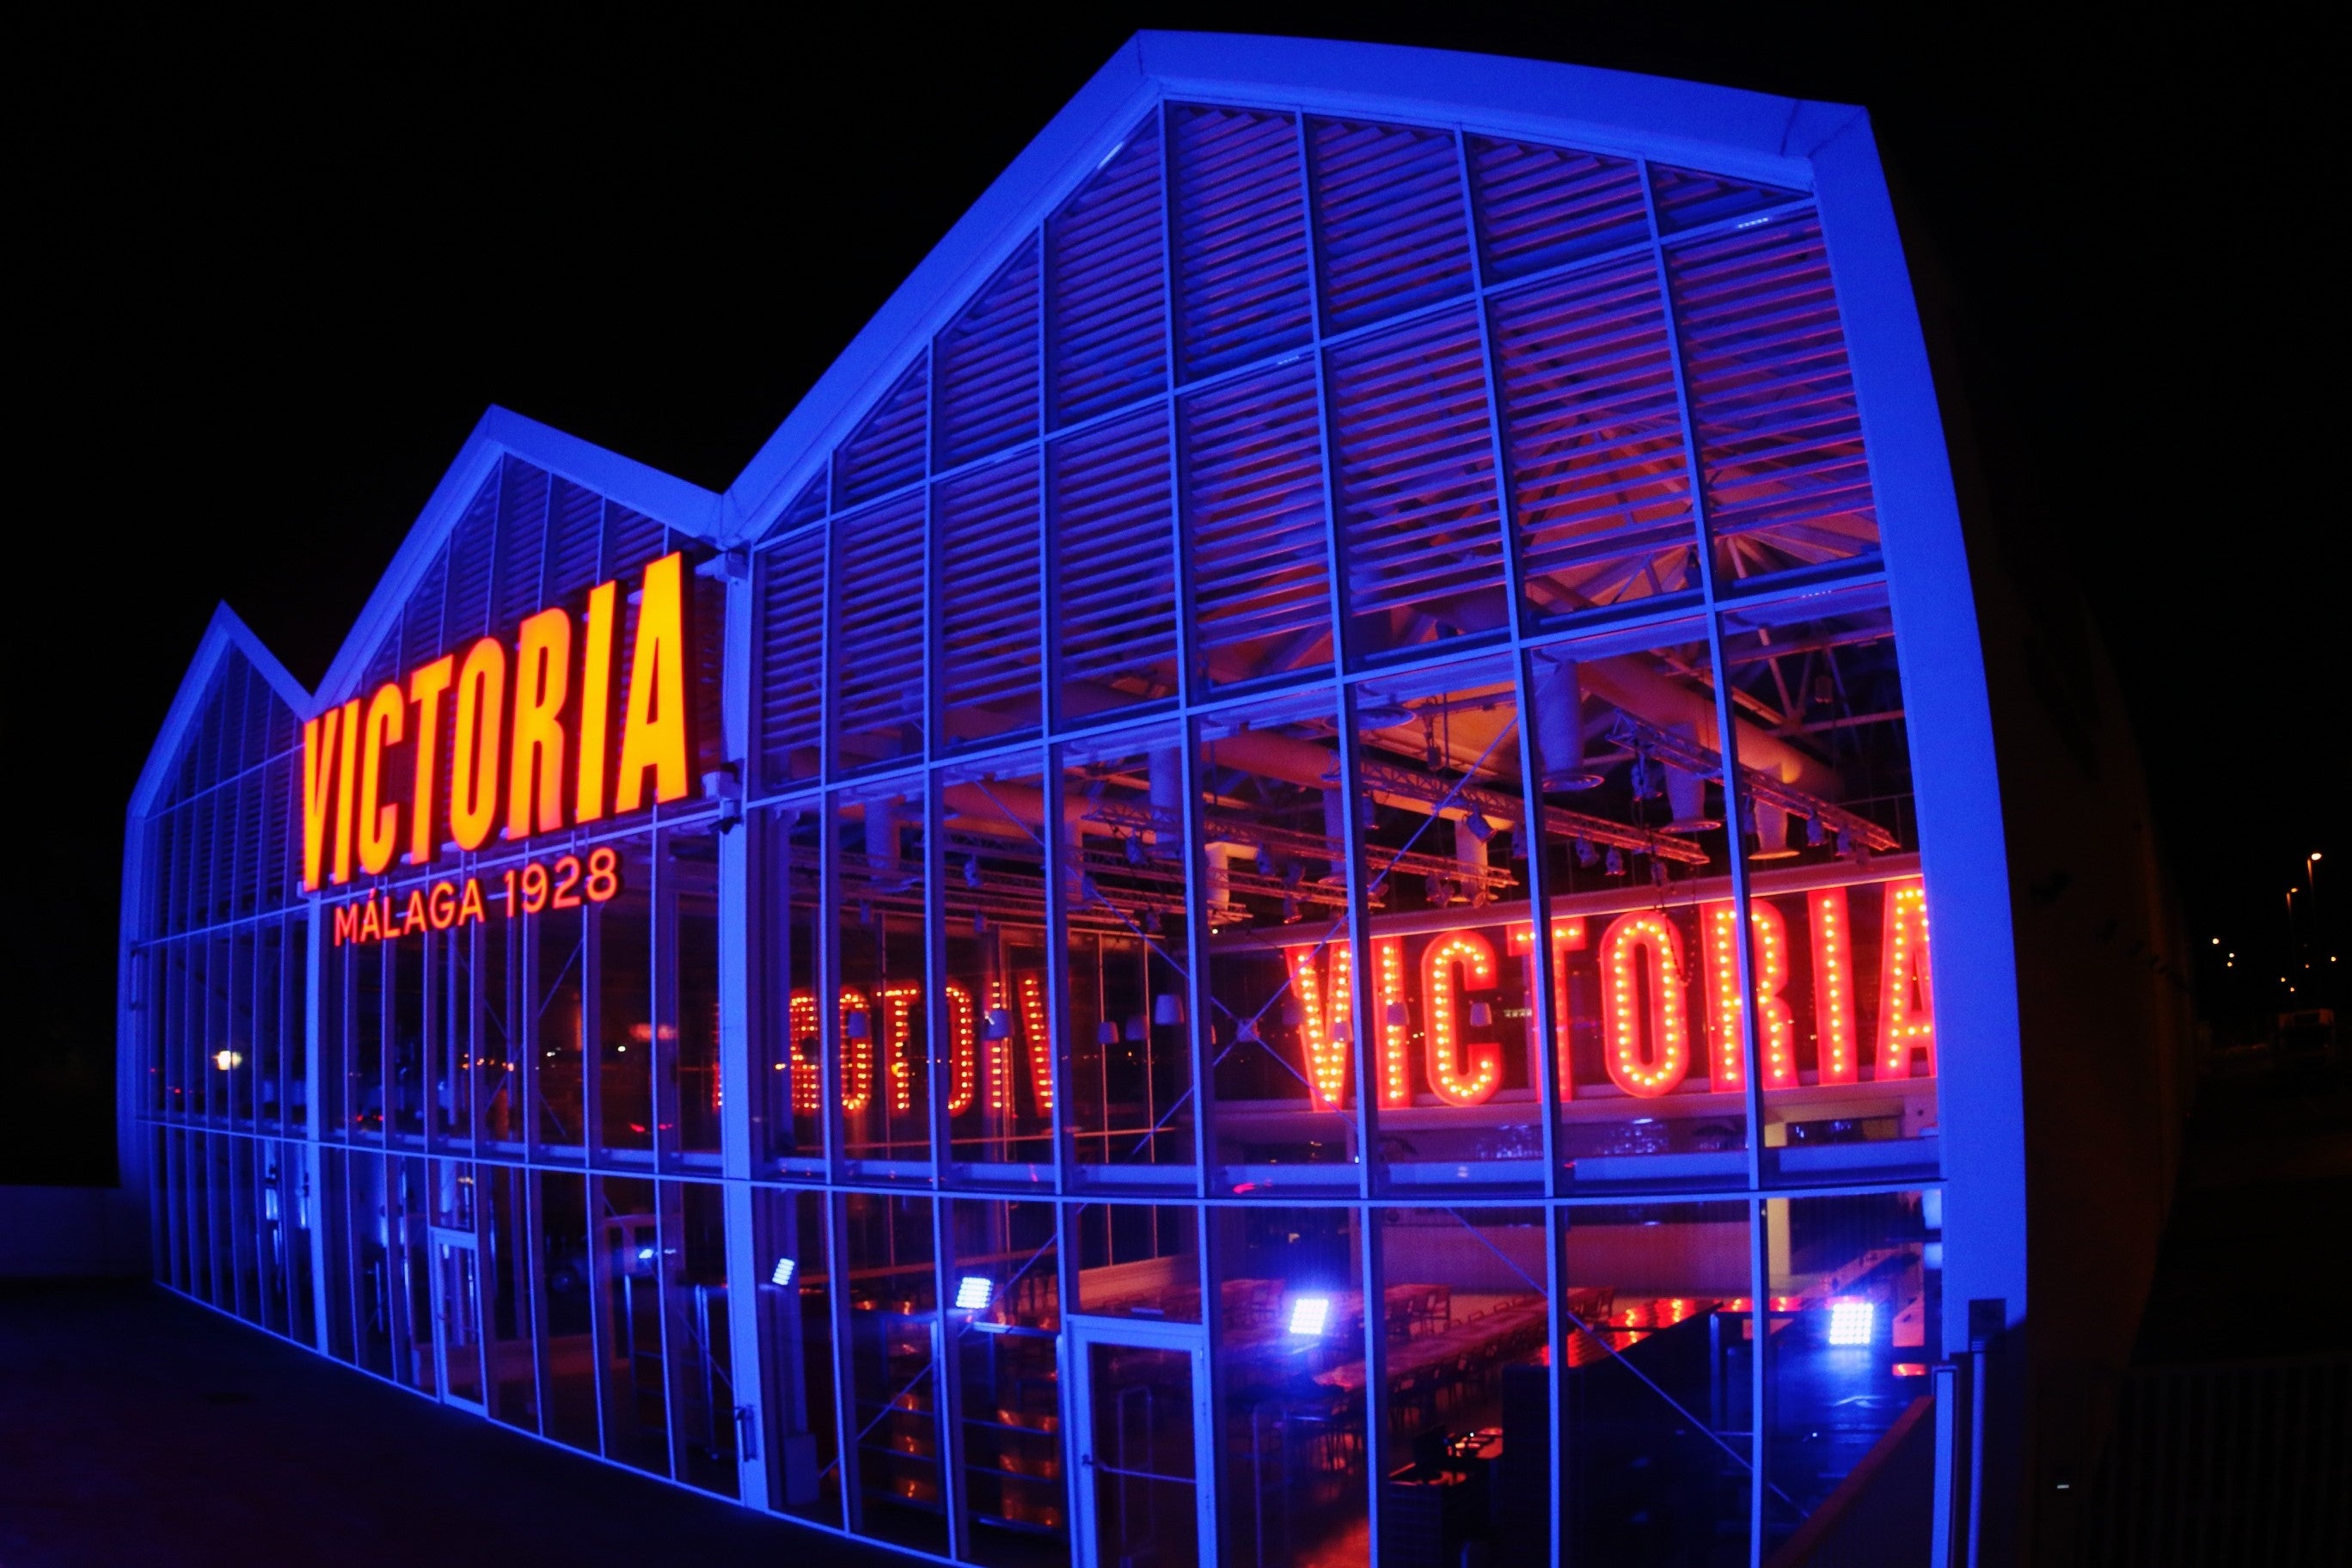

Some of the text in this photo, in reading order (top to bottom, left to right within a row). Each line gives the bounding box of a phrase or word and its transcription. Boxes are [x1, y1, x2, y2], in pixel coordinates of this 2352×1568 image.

[303, 551, 688, 892] VICTORIA
[334, 847, 618, 946] MÁLAGA 1928
[1284, 876, 1938, 1112] VICTORIA
